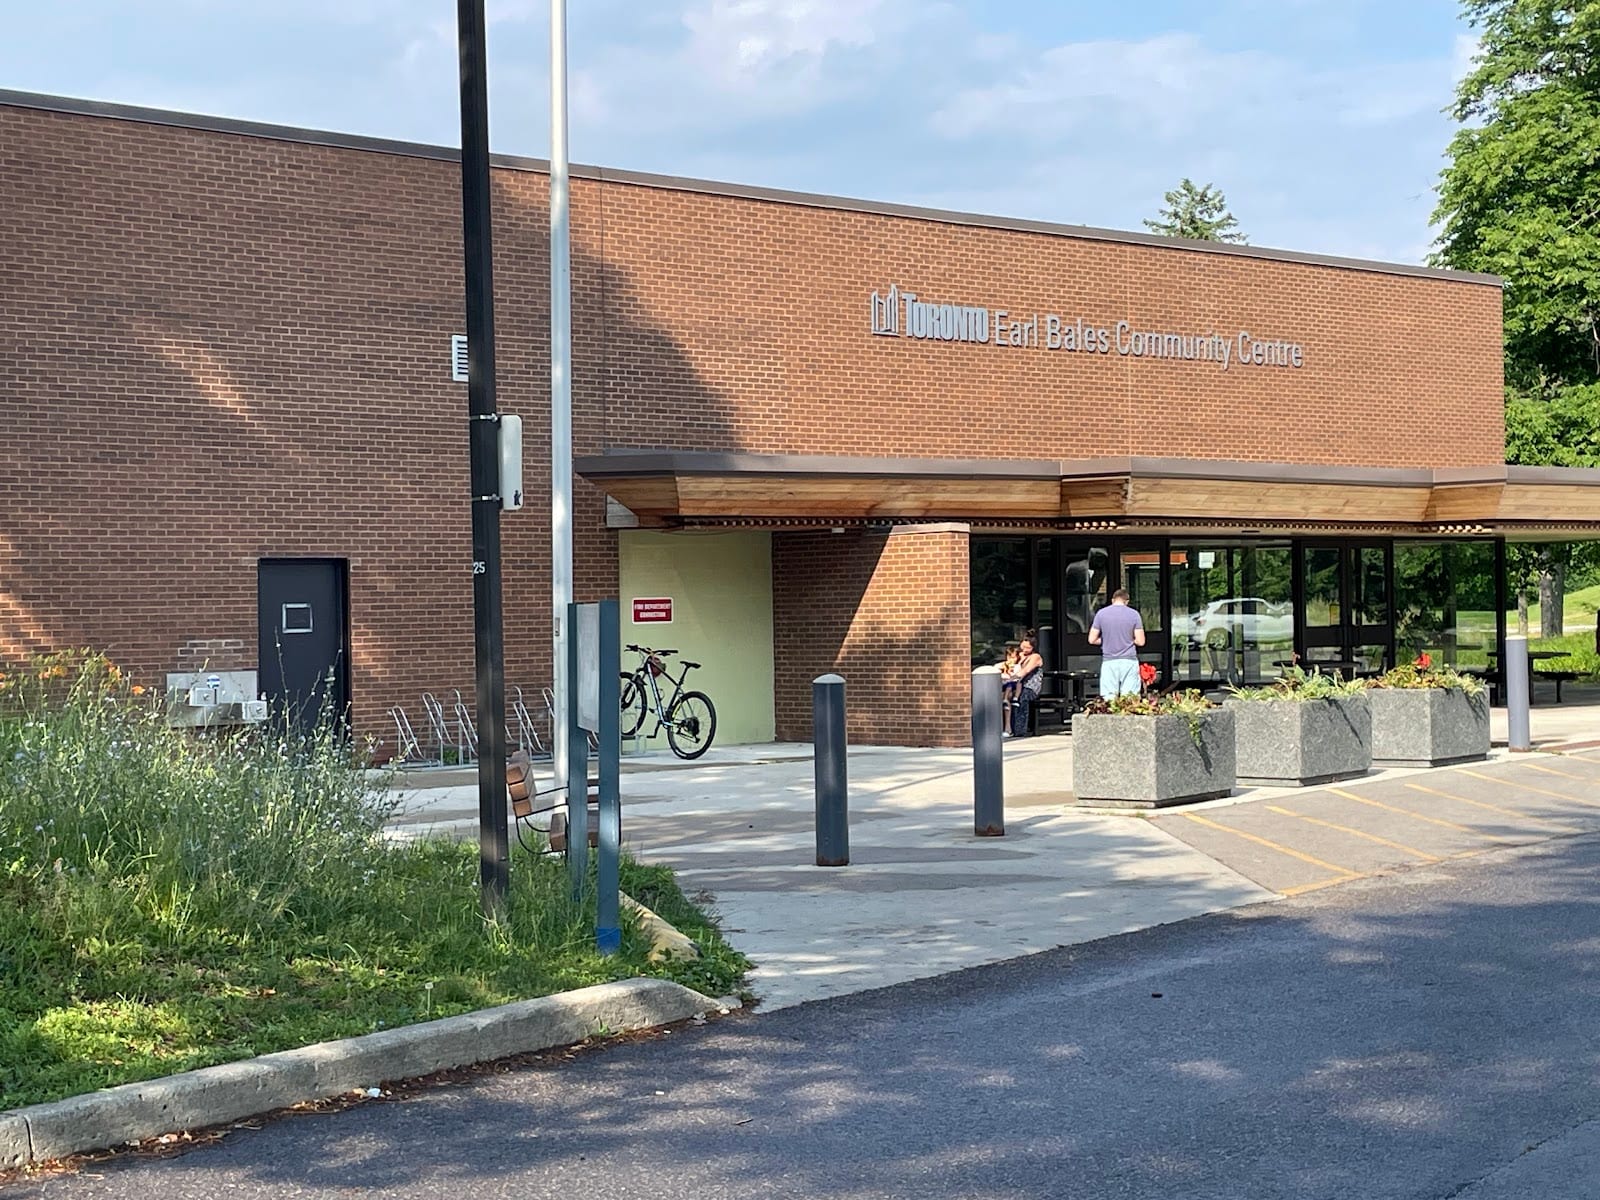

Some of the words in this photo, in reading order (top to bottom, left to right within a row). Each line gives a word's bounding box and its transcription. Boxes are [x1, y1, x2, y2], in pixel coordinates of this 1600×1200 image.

[903, 293, 990, 343] TORONTO
[994, 311, 1039, 348] Earl
[1046, 314, 1110, 354] Bales
[1115, 321, 1233, 370] Community
[1236, 330, 1304, 368] Centre
[473, 561, 486, 575] 25
